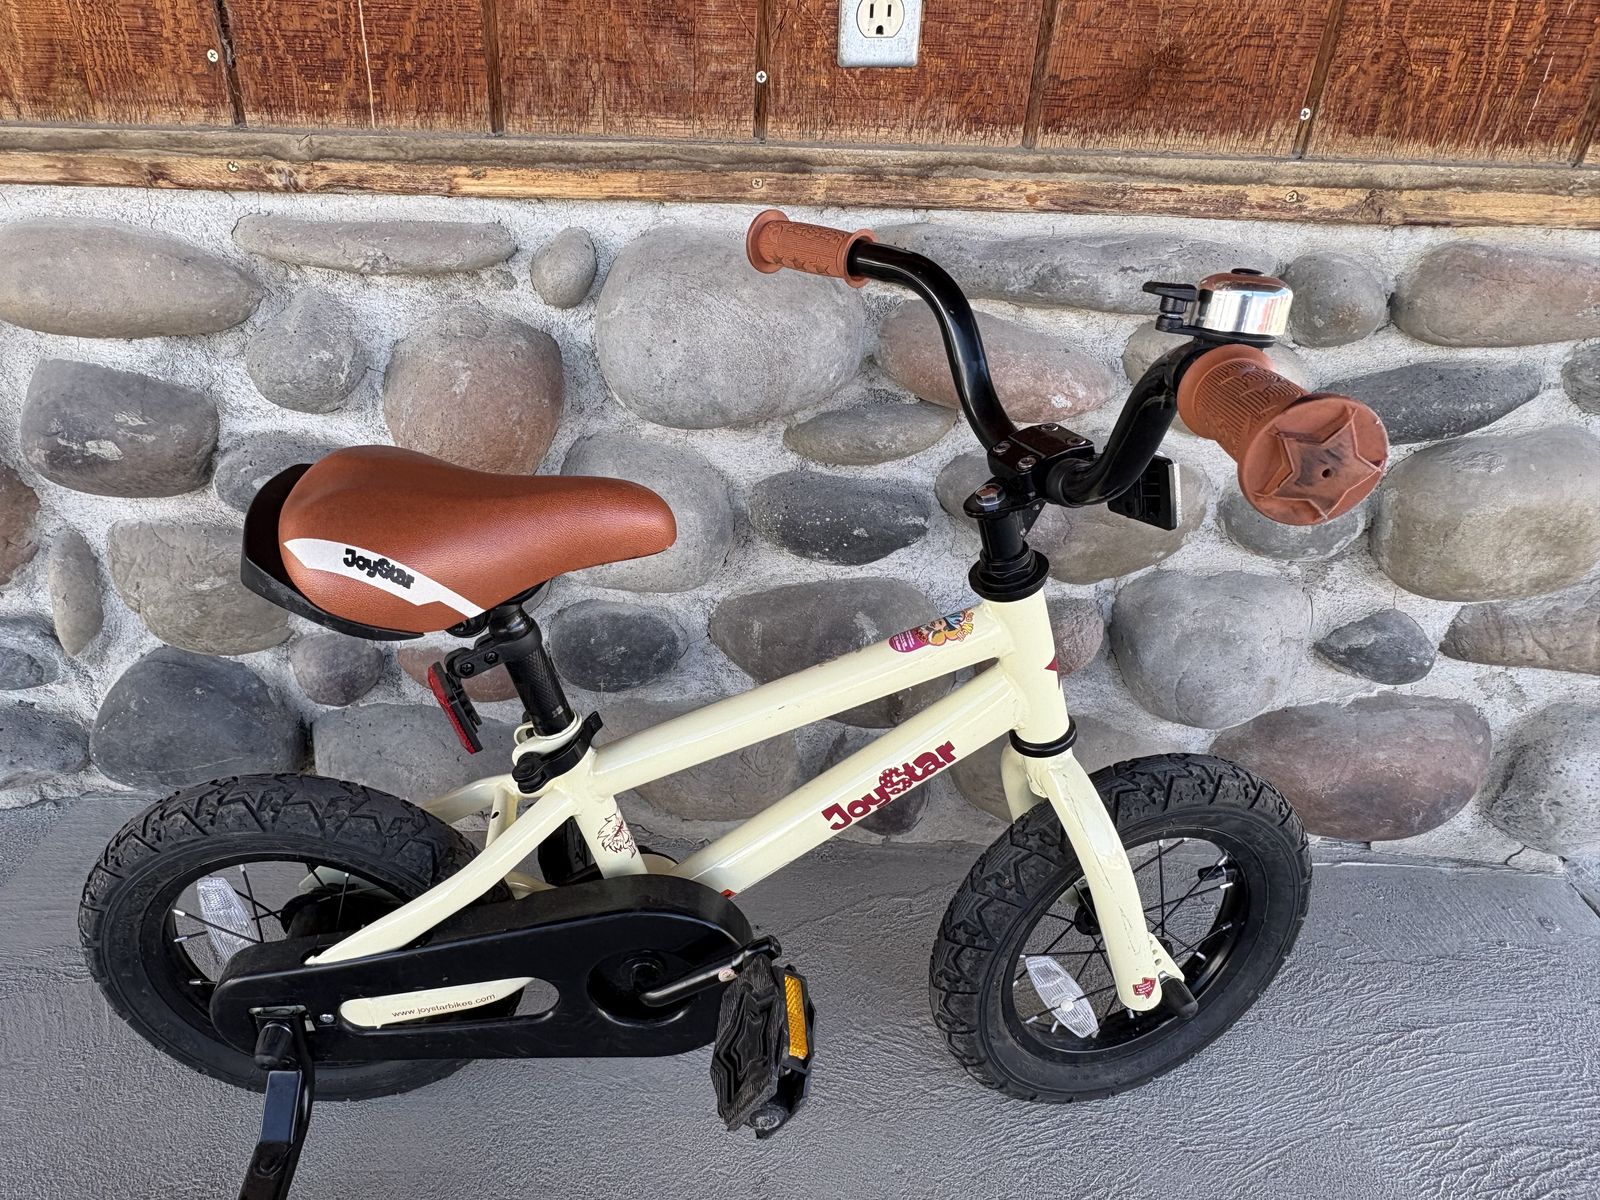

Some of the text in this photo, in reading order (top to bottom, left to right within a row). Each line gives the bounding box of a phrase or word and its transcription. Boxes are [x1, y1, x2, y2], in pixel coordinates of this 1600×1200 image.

[343, 548, 415, 589] JoyStar
[821, 740, 956, 831] JoyStar
[391, 993, 496, 1018] www.joystarbikes.com
